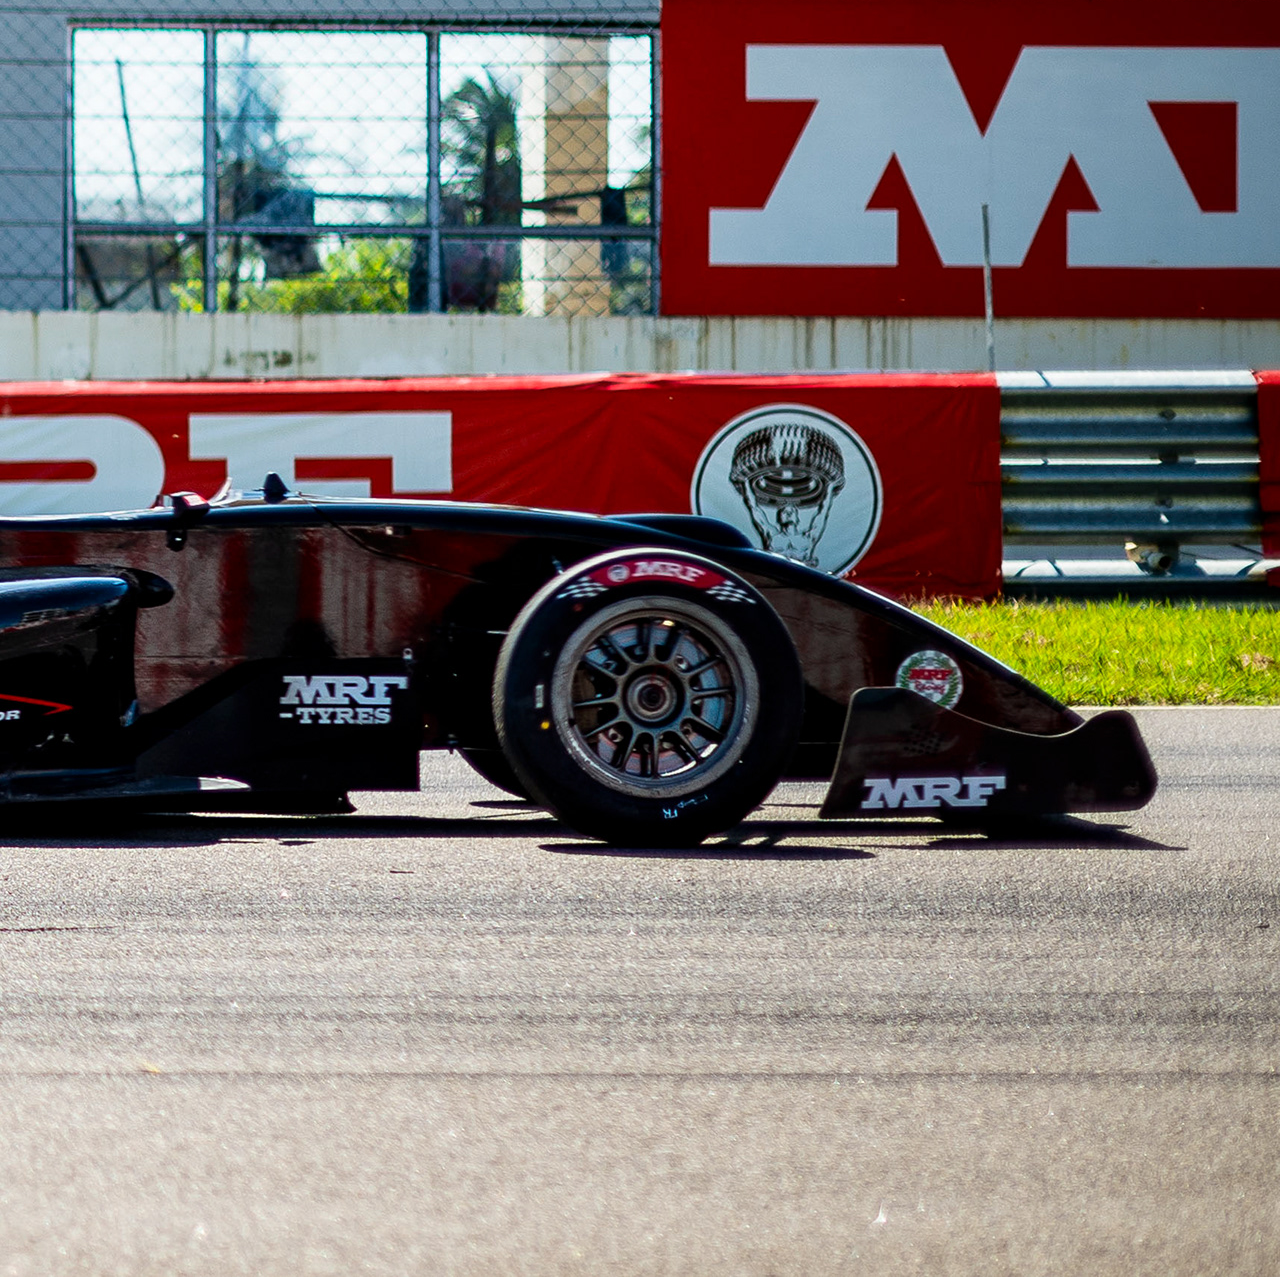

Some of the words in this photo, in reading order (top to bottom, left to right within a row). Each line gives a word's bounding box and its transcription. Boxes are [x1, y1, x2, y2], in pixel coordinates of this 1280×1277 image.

[632, 561, 707, 583] MRF
[908, 669, 953, 681] MRF
[280, 676, 408, 705] MRF
[861, 776, 1006, 809] MRF
